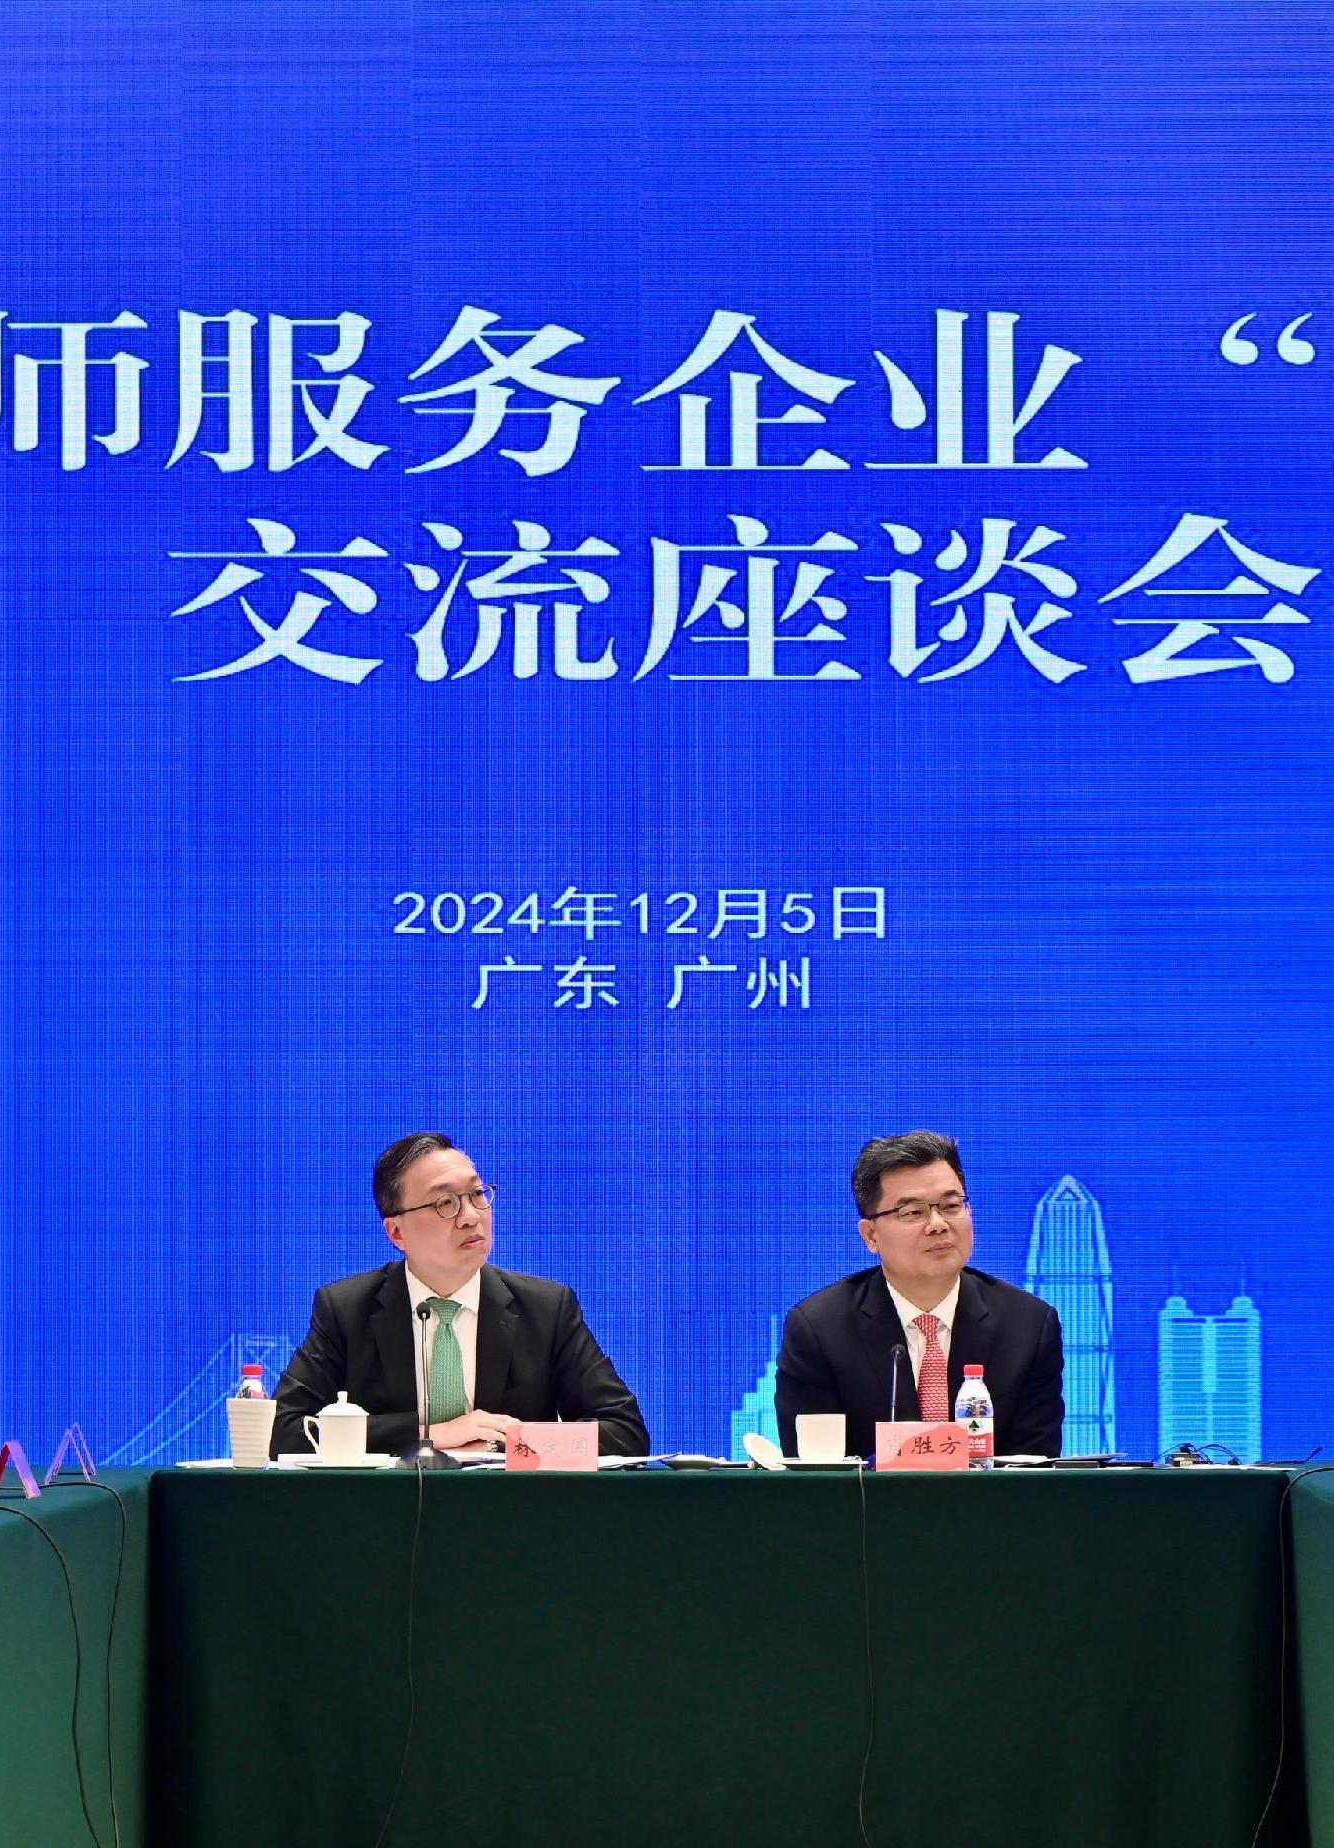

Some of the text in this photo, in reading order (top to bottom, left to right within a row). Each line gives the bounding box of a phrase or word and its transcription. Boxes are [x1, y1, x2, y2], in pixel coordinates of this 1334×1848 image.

[169, 512, 1321, 684] 交流座谈会
[392, 886, 885, 940] 2024年12月5日
[471, 956, 810, 1009] 广东 广州
